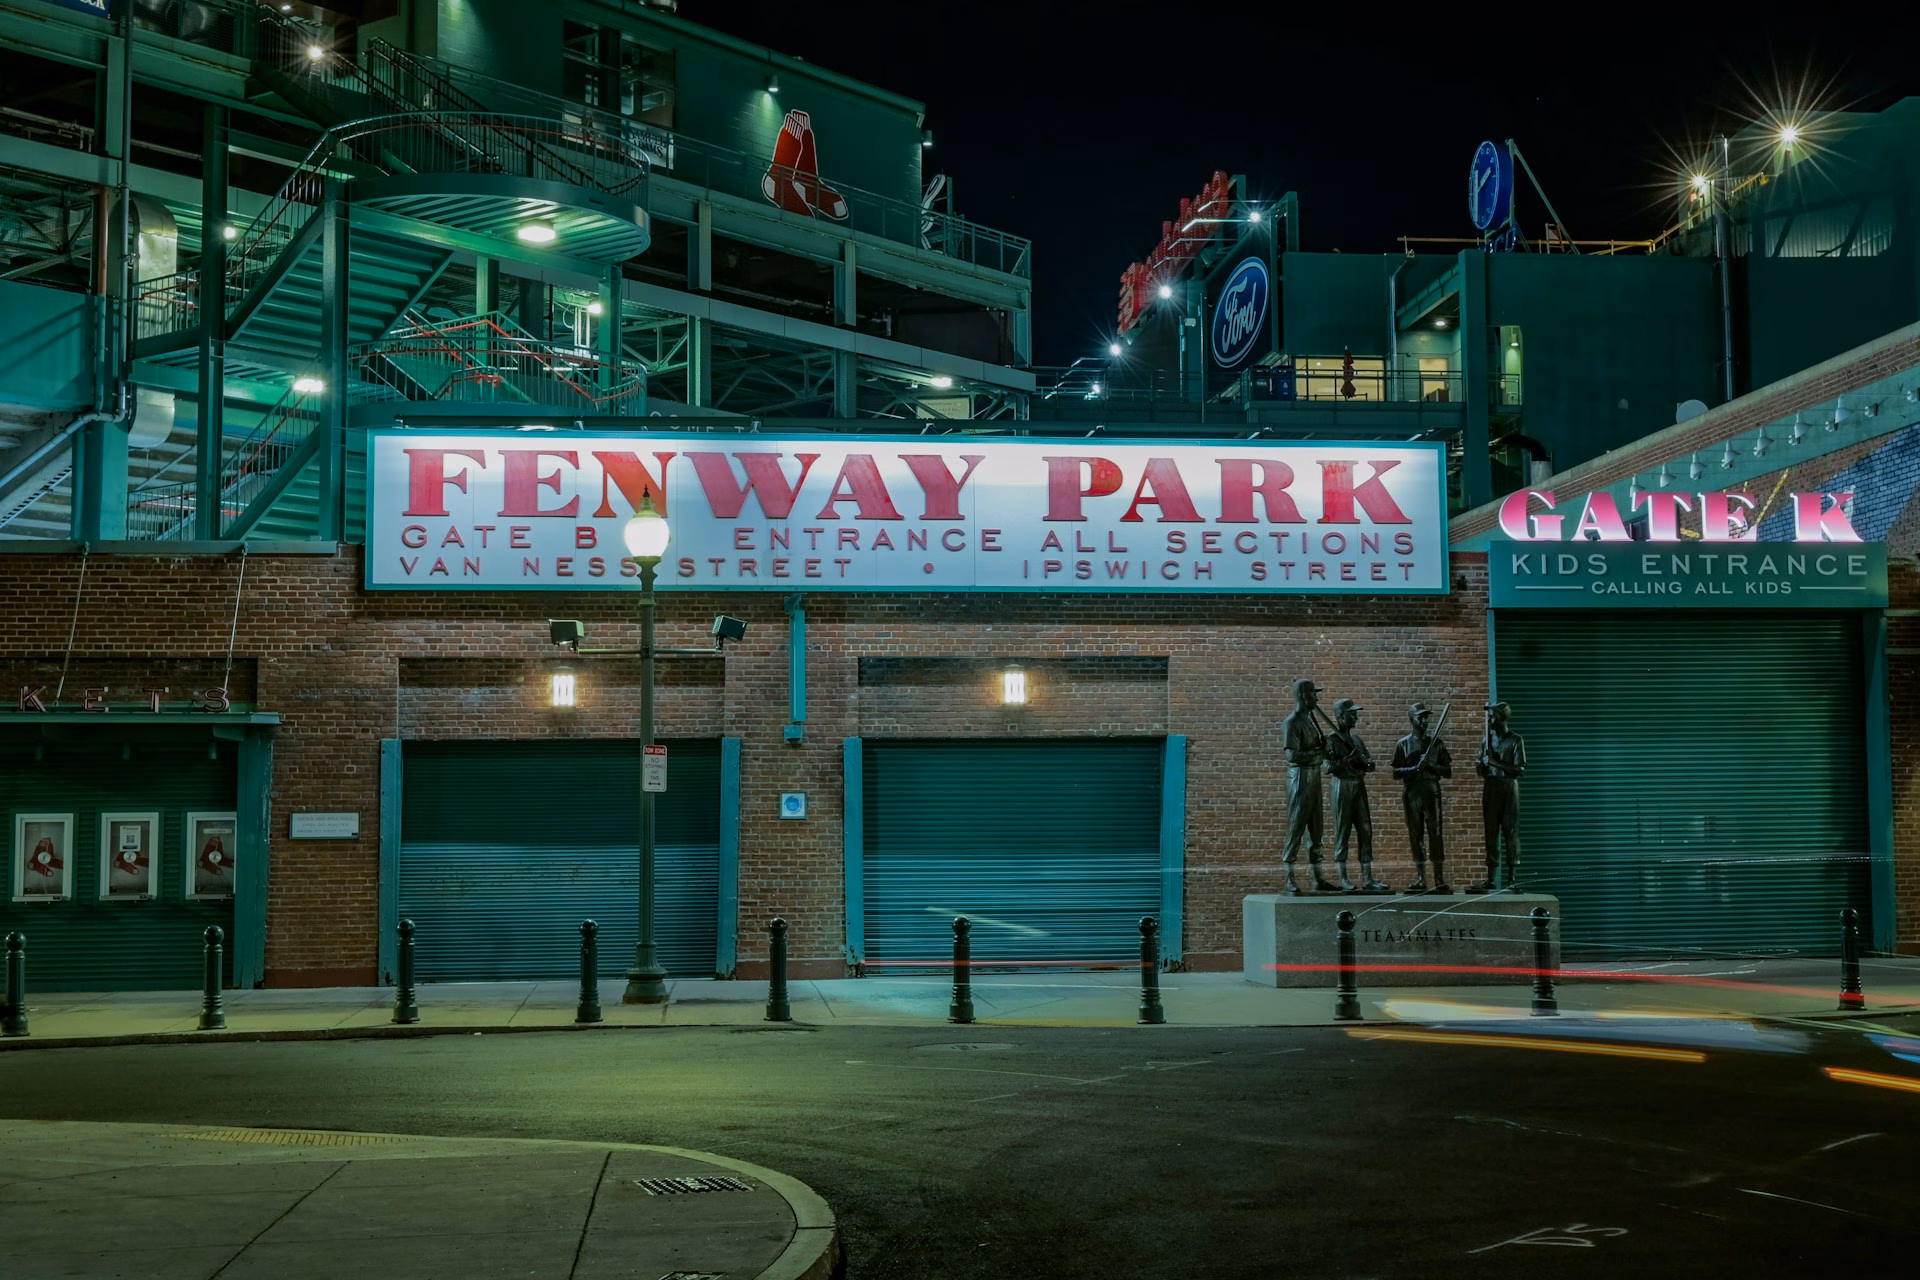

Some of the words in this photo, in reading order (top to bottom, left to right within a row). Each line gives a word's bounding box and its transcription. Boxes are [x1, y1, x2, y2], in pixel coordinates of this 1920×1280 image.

[1222, 276, 1257, 354] Ford
[402, 448, 986, 520] FENWAY
[1041, 456, 1412, 524] PARK
[1498, 489, 1758, 542] GATE
[1789, 491, 1864, 543] K
[402, 524, 531, 548] GATE
[576, 526, 598, 548] B
[735, 527, 1002, 551] ENTRANCE
[1040, 529, 1128, 552] ALL
[1166, 530, 1414, 554] SECTIONS
[400, 556, 480, 576] VAN
[523, 556, 638, 577] NESS
[677, 557, 851, 577] STREET
[1024, 559, 1213, 580] IPSWICH
[1251, 560, 1415, 581] STREET
[1512, 554, 1608, 576] KIDS
[1642, 554, 1868, 576] ENTRANCE
[1591, 581, 1682, 595] CALLING
[1694, 581, 1733, 595] ALL
[1745, 581, 1792, 595] KIDS
[19, 685, 231, 713] KETS
[1361, 928, 1476, 942] TEAMMATES
